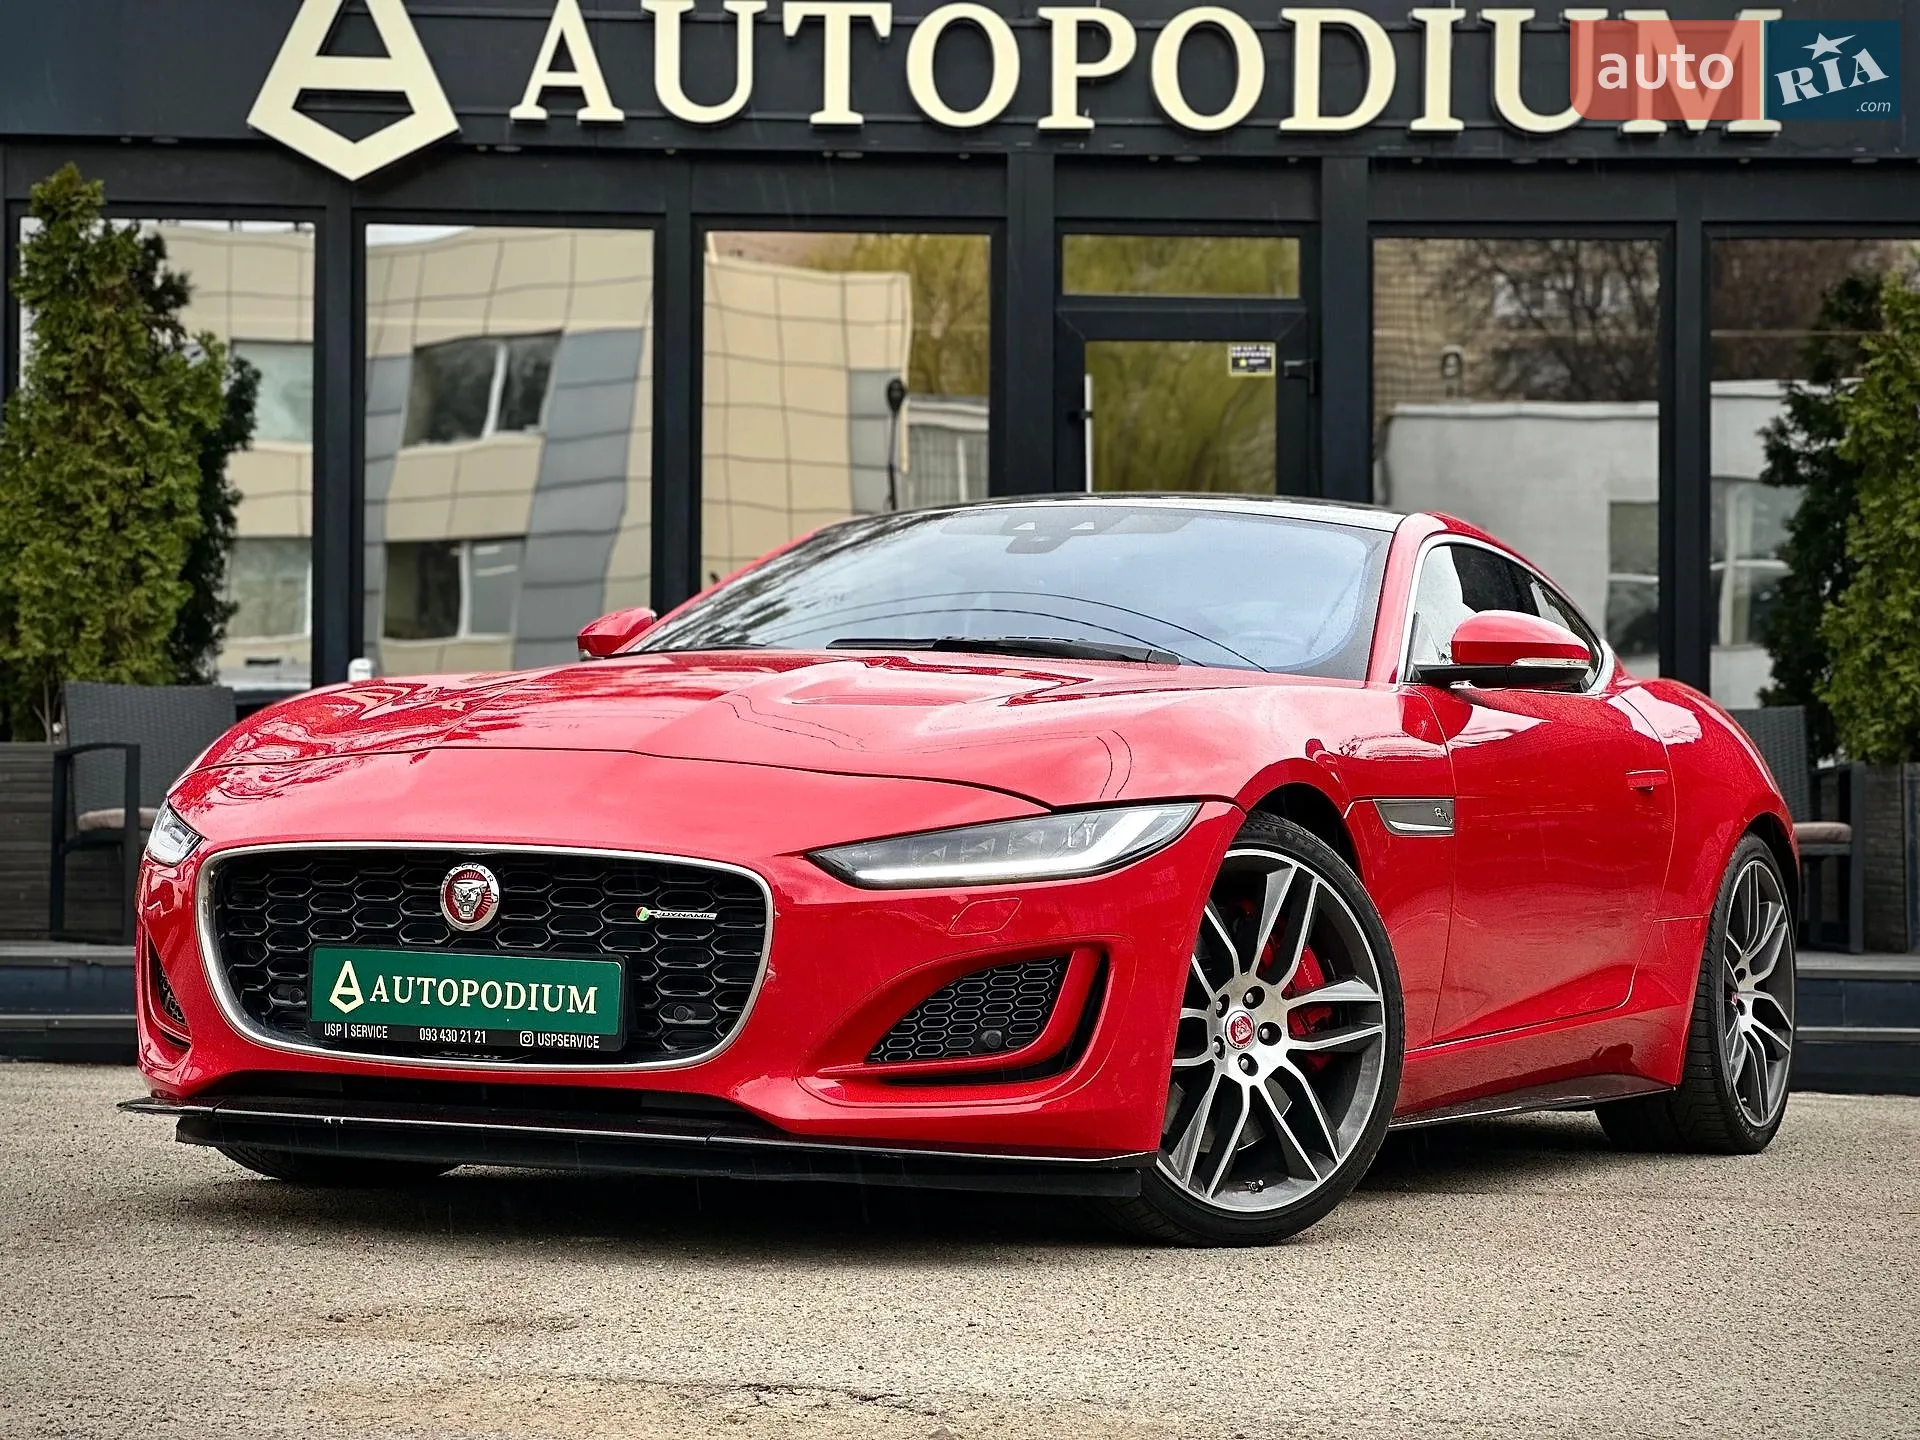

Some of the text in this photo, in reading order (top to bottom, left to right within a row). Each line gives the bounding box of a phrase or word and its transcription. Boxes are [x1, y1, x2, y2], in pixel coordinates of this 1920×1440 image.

[509, 0, 1783, 134] AUTOPODIUM
[369, 974, 598, 1015] AUTOPODIUM
[324, 1023, 388, 1039] USP SERVICE
[419, 1027, 487, 1044] 093 430 21 21
[537, 1032, 600, 1049] USPSERVICE
